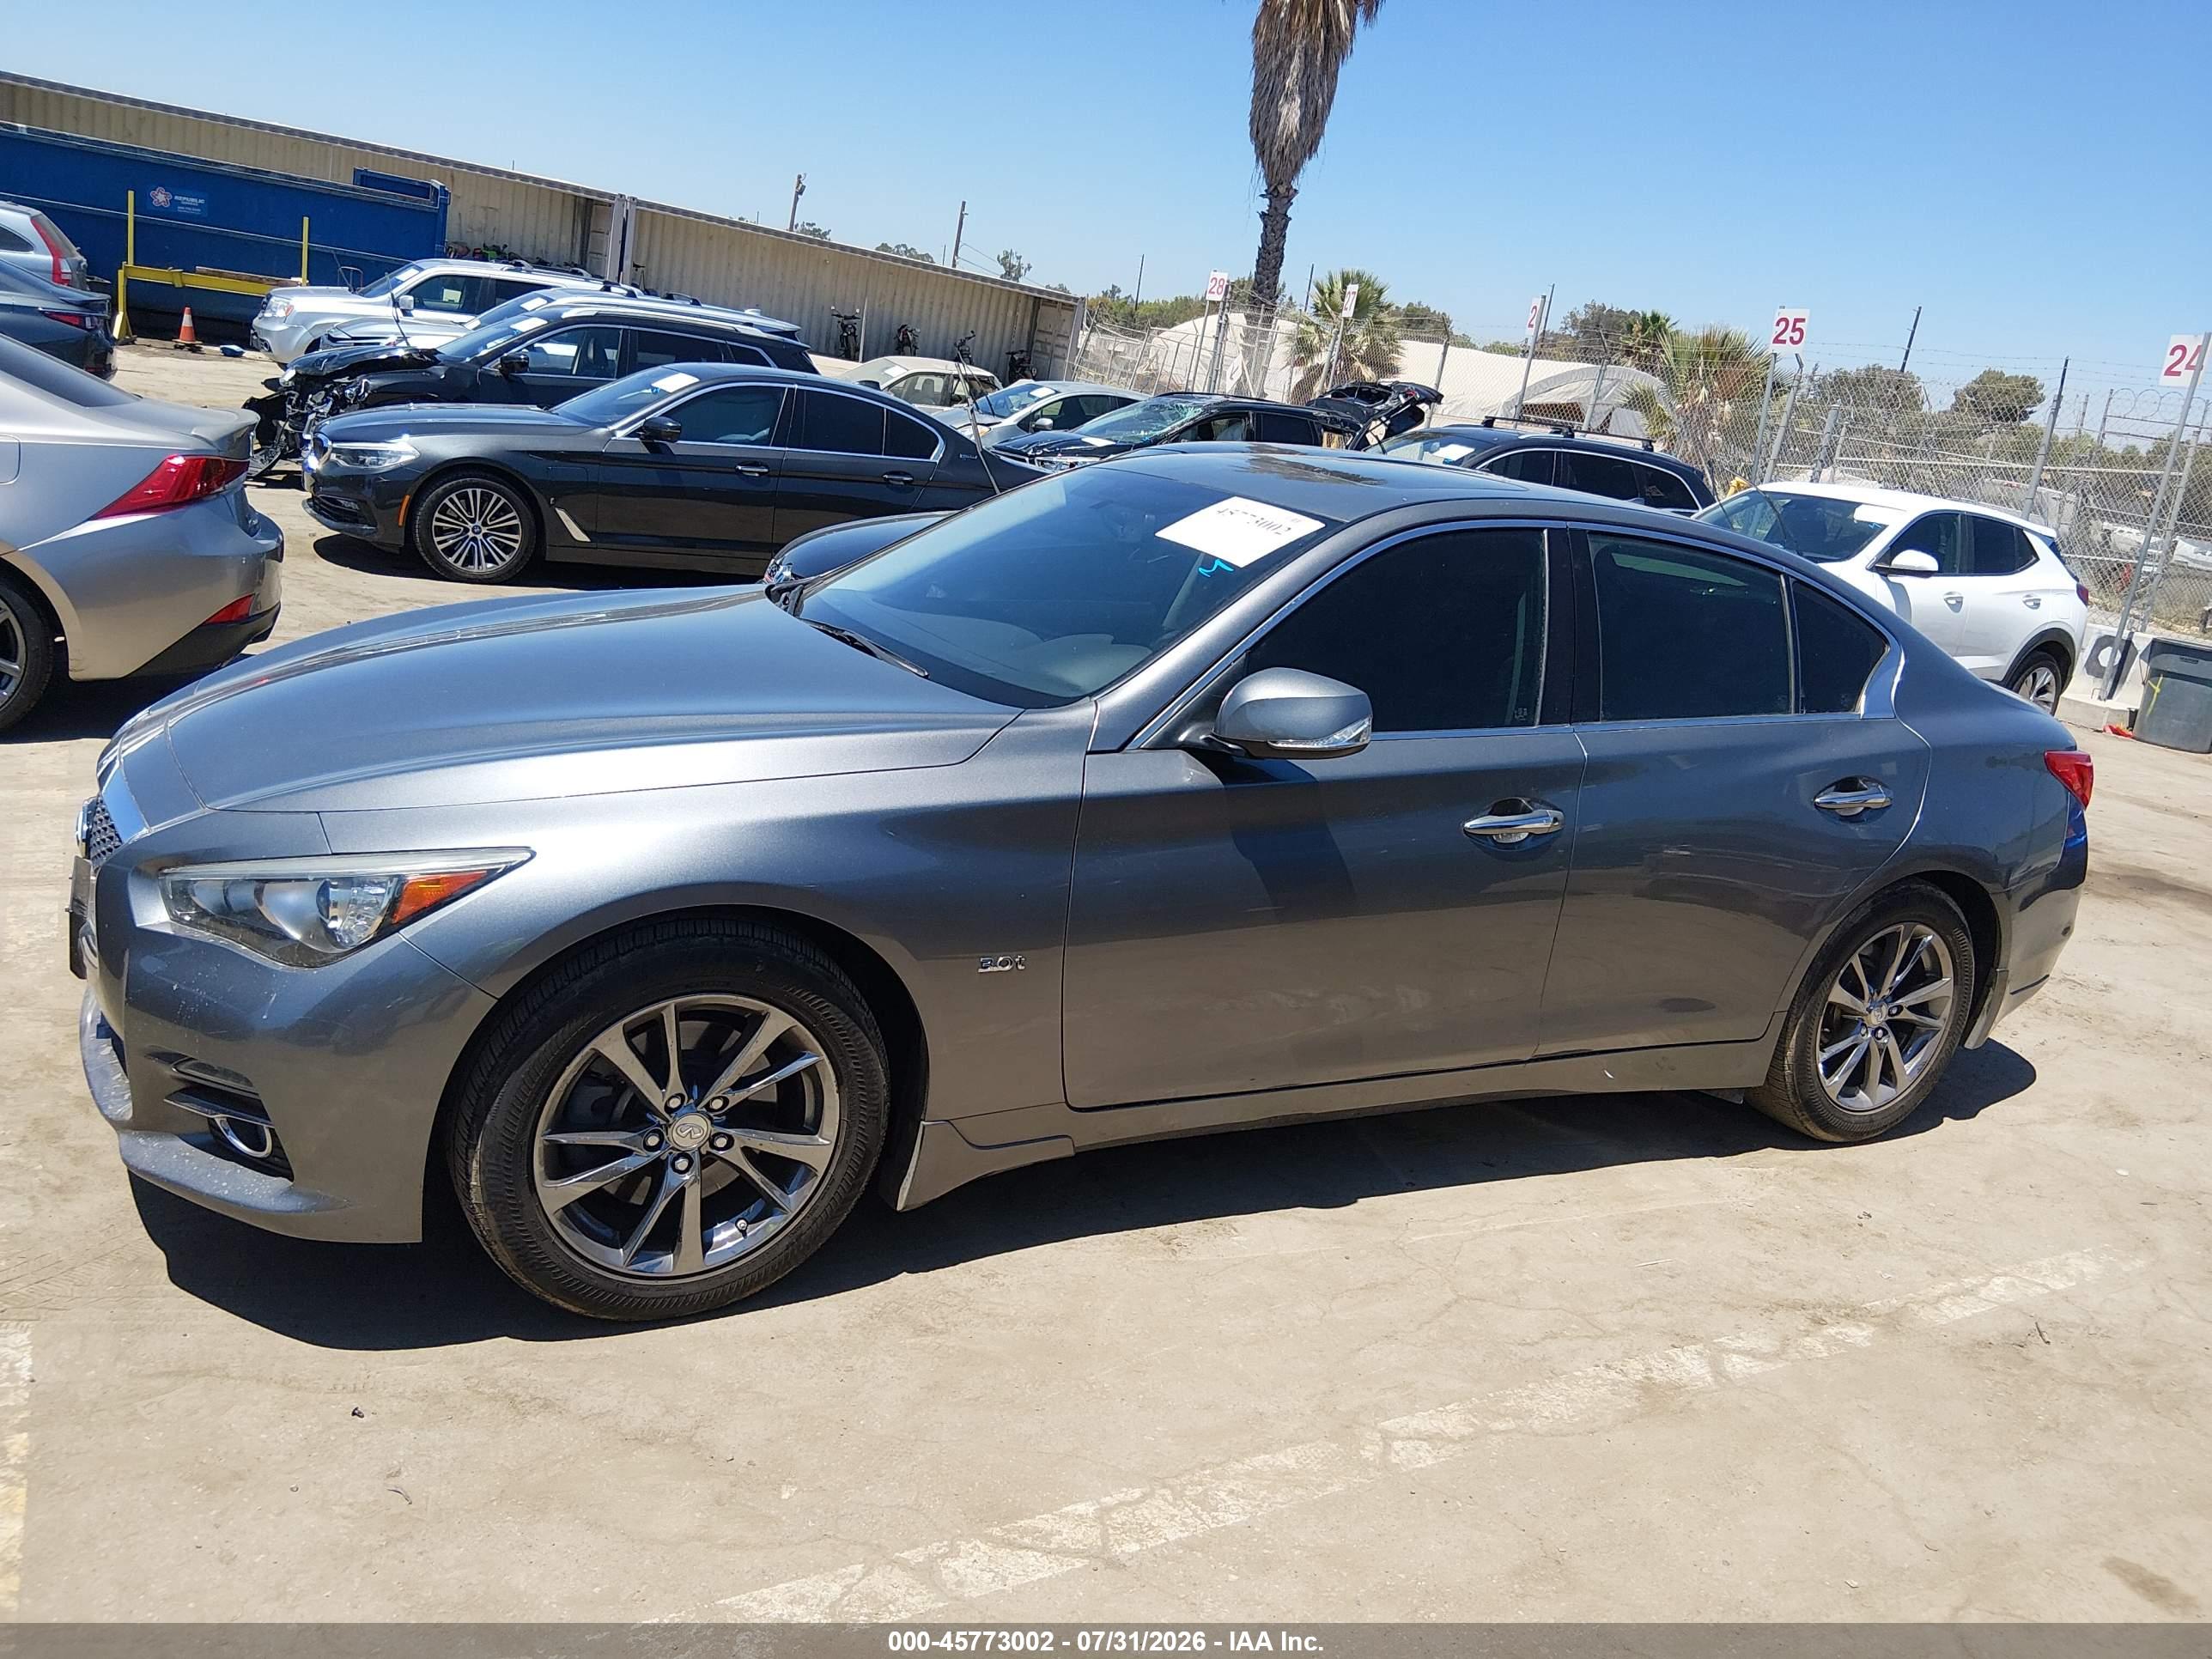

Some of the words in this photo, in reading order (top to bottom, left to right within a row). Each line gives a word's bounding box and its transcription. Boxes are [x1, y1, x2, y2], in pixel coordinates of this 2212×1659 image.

[1208, 276, 1225, 295] 28
[1343, 290, 1357, 311] 27
[1771, 317, 1806, 345] 25
